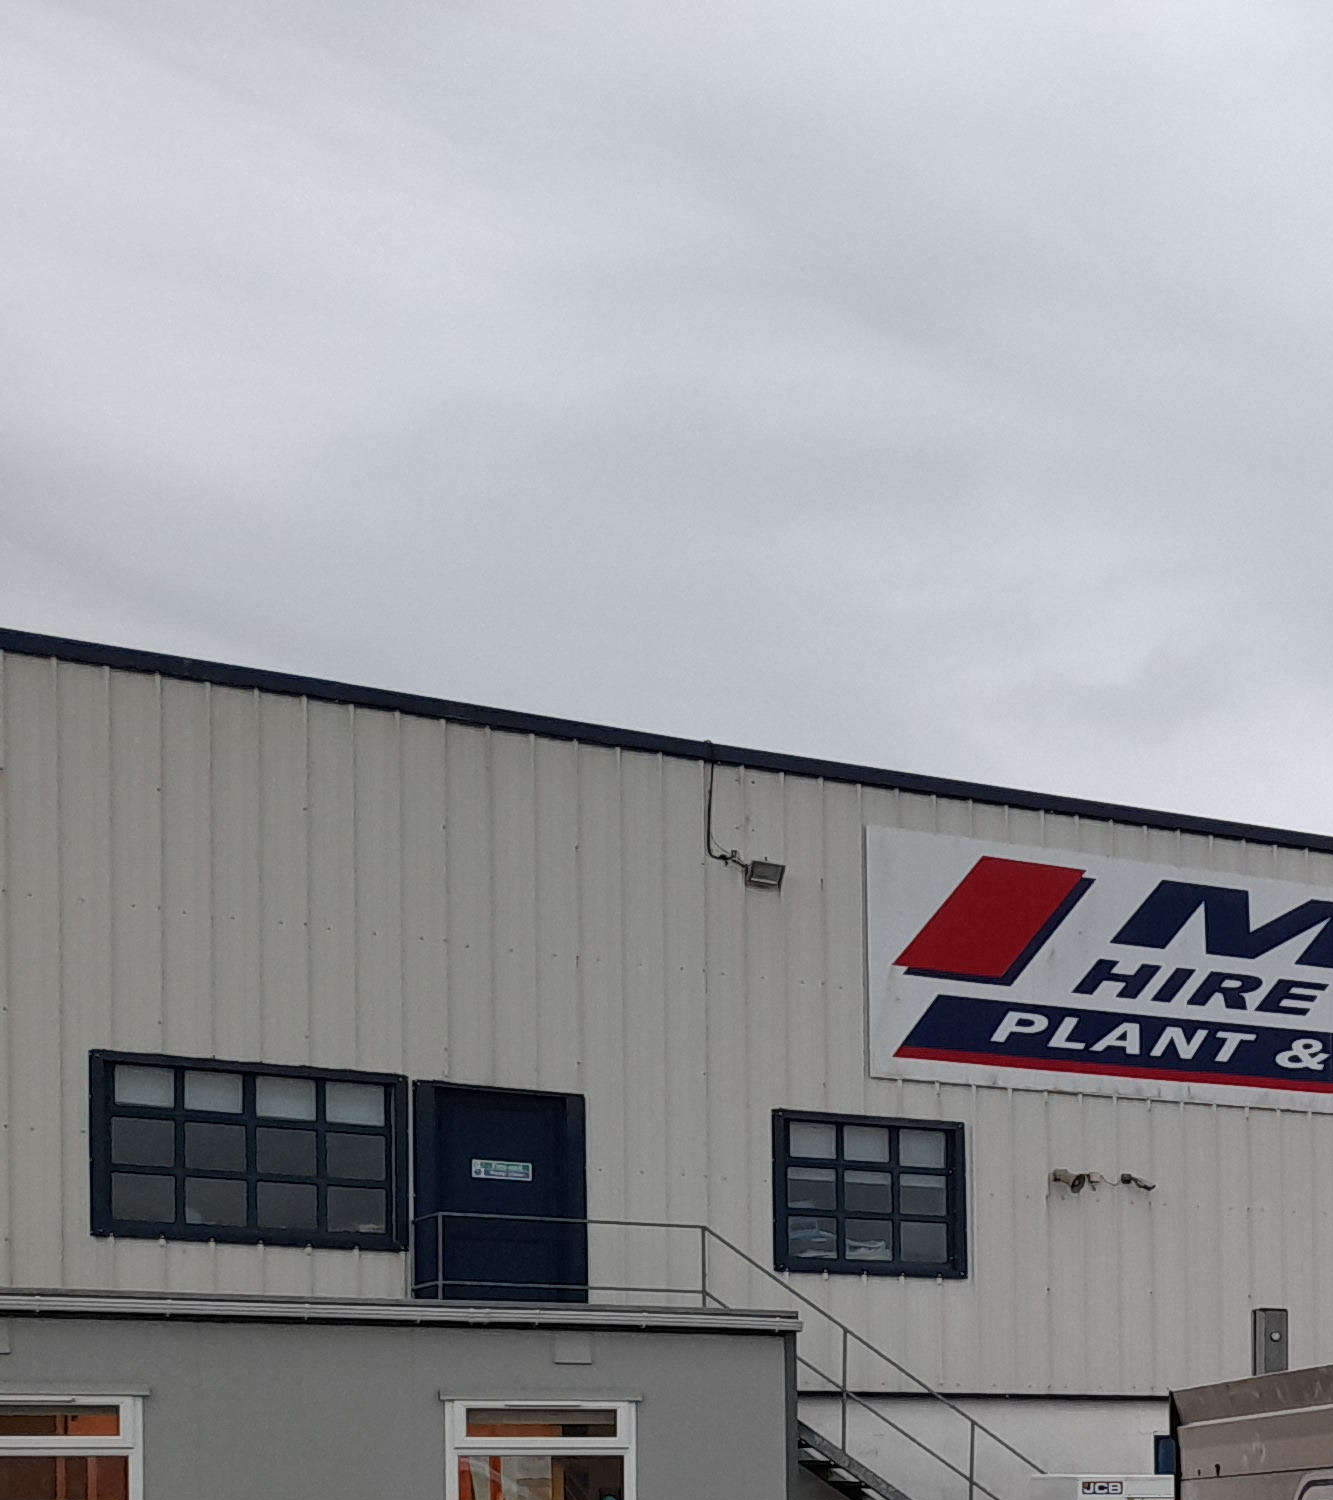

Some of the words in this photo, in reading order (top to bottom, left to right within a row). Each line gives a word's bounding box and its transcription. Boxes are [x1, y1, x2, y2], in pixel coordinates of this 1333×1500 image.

[1071, 958, 1330, 1017] HIRE
[990, 1010, 1257, 1063] PLANT
[1274, 1037, 1332, 1071] &
[1083, 1482, 1122, 1494] JCB
